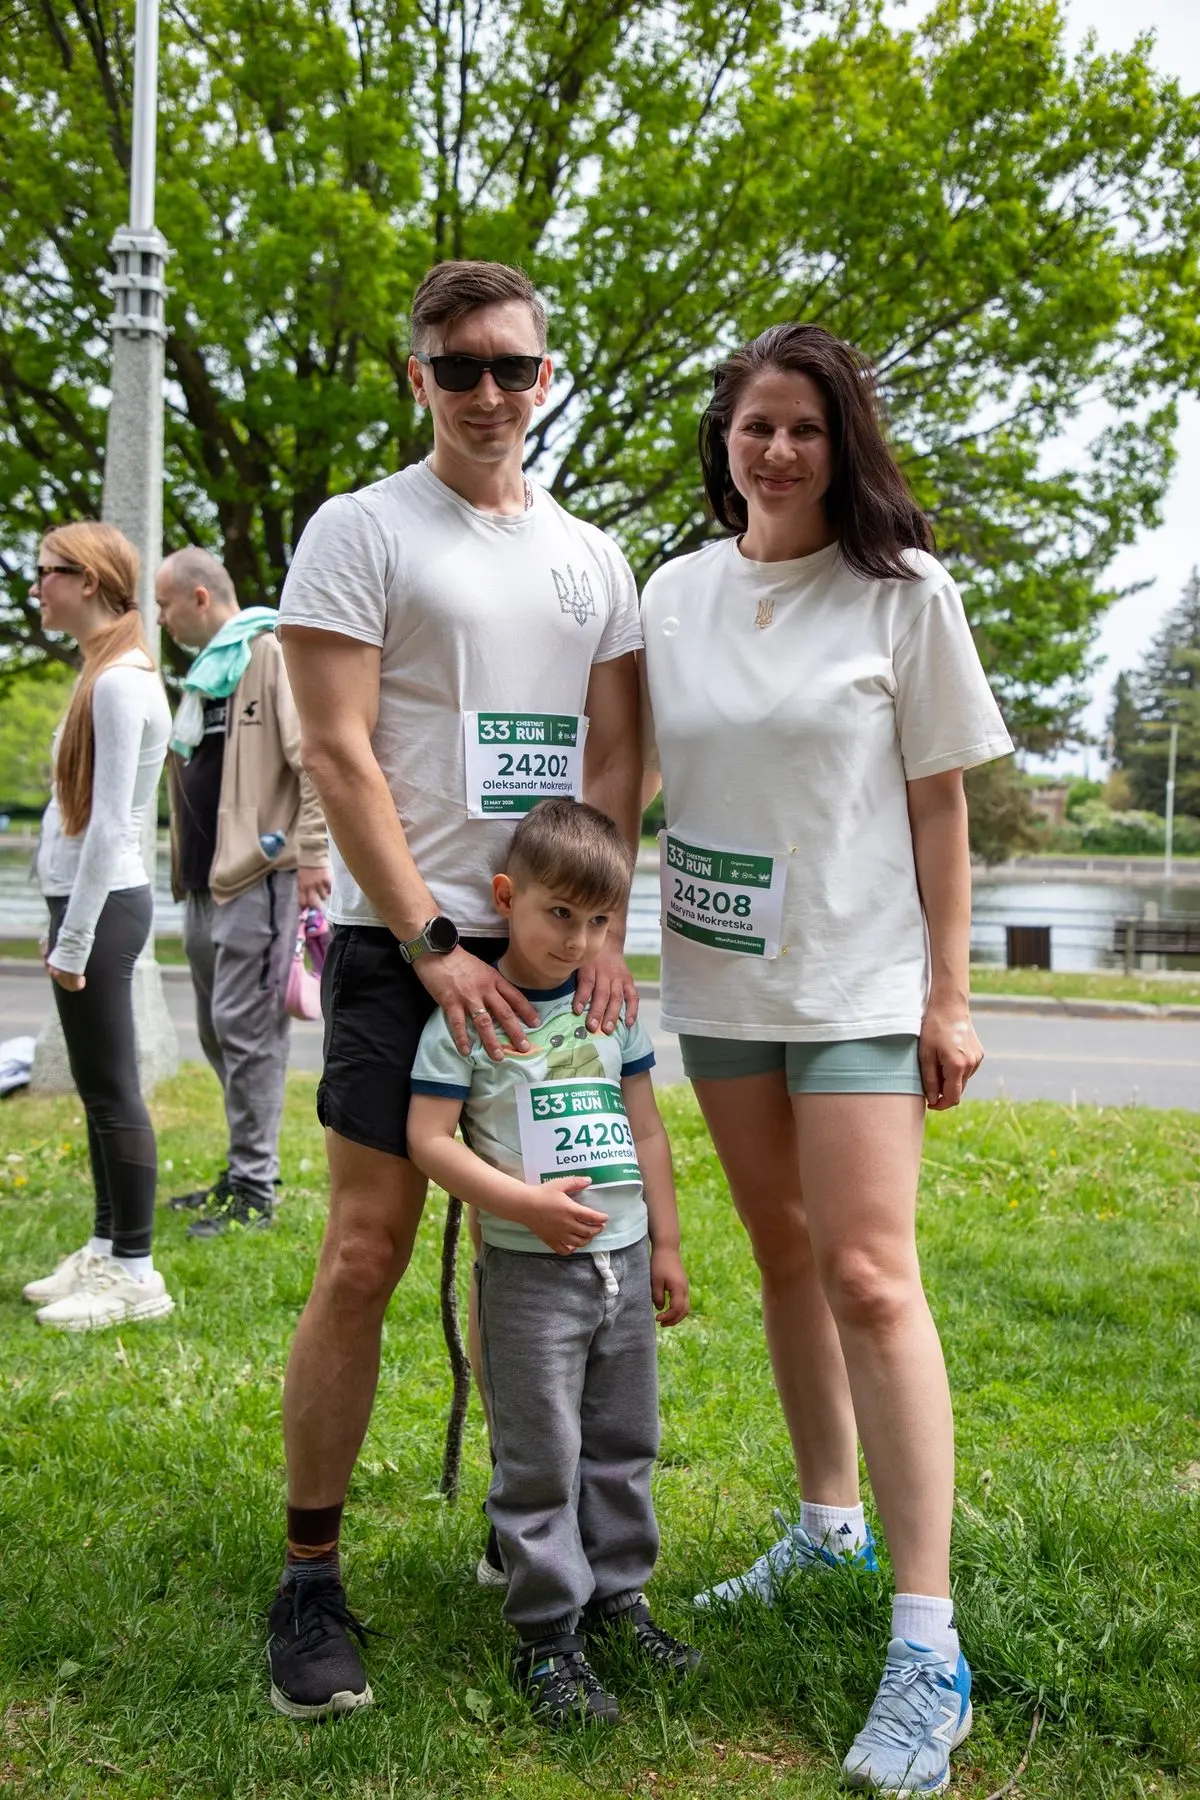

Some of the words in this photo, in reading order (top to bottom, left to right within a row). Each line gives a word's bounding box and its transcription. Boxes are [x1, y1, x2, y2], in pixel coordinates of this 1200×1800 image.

[516, 728, 545, 741] RUN
[497, 753, 568, 778] 24202
[482, 780, 538, 790] Oleksandr
[686, 858, 712, 877] RUN
[673, 878, 752, 918] 24208
[670, 900, 696, 919] Maryna
[697, 914, 754, 932] Mokretska
[572, 1097, 603, 1112] RUN
[553, 1122, 633, 1152] 24203
[556, 1152, 587, 1165] Leon
